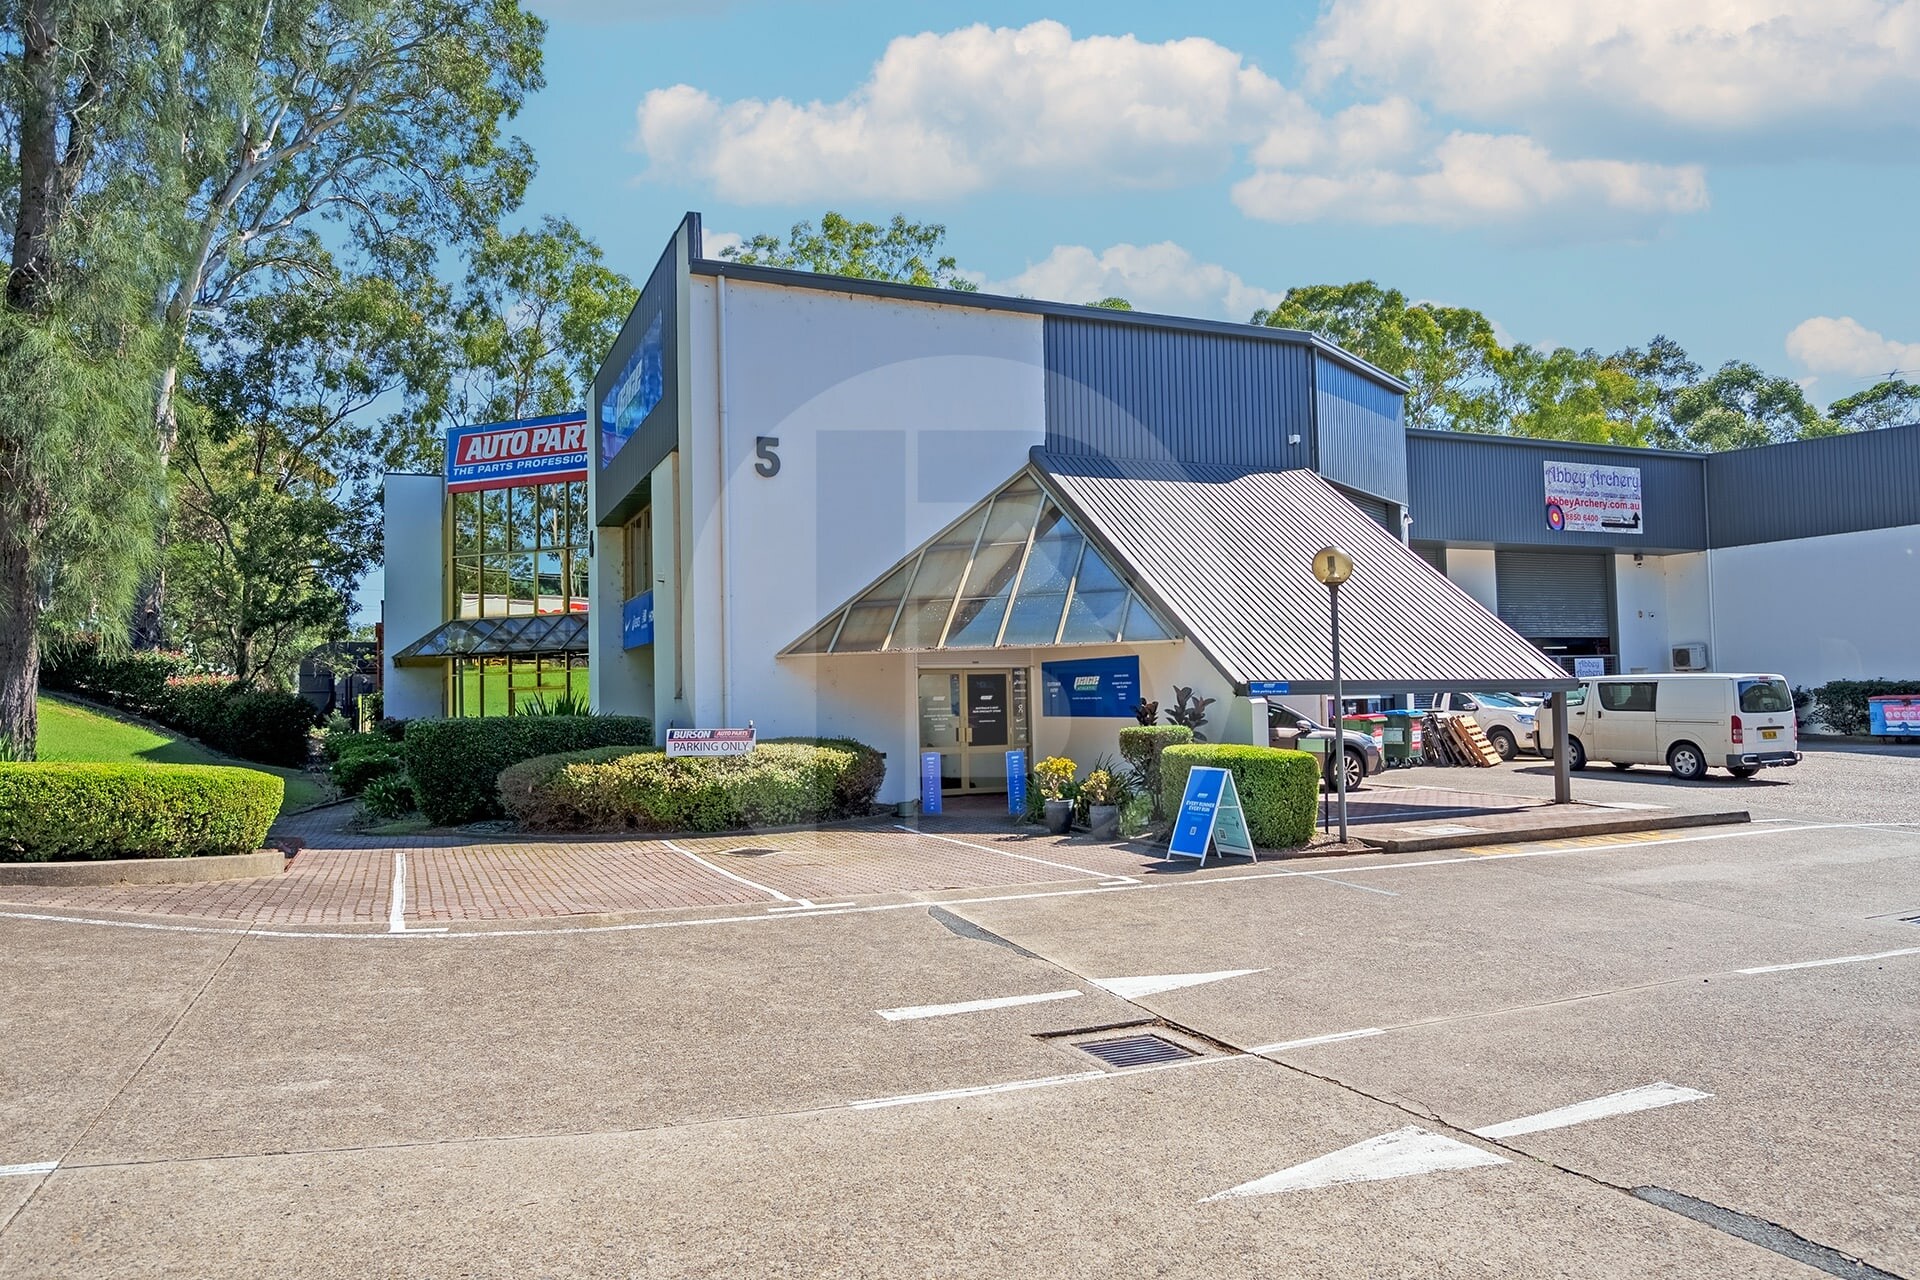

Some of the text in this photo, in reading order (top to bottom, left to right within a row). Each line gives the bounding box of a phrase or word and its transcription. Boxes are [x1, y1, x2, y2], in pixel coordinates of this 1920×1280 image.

[465, 430, 528, 461] AUTO
[755, 436, 780, 478] 5
[453, 466, 474, 476] THE
[477, 462, 513, 474] PARTS
[1546, 466, 1639, 492] Abbey Archery
[1545, 496, 1640, 511] AbbeyArchery.com.au
[1578, 660, 1600, 669] Abbey
[673, 730, 711, 739] BURSON
[673, 742, 749, 752] PARKING ONLY
